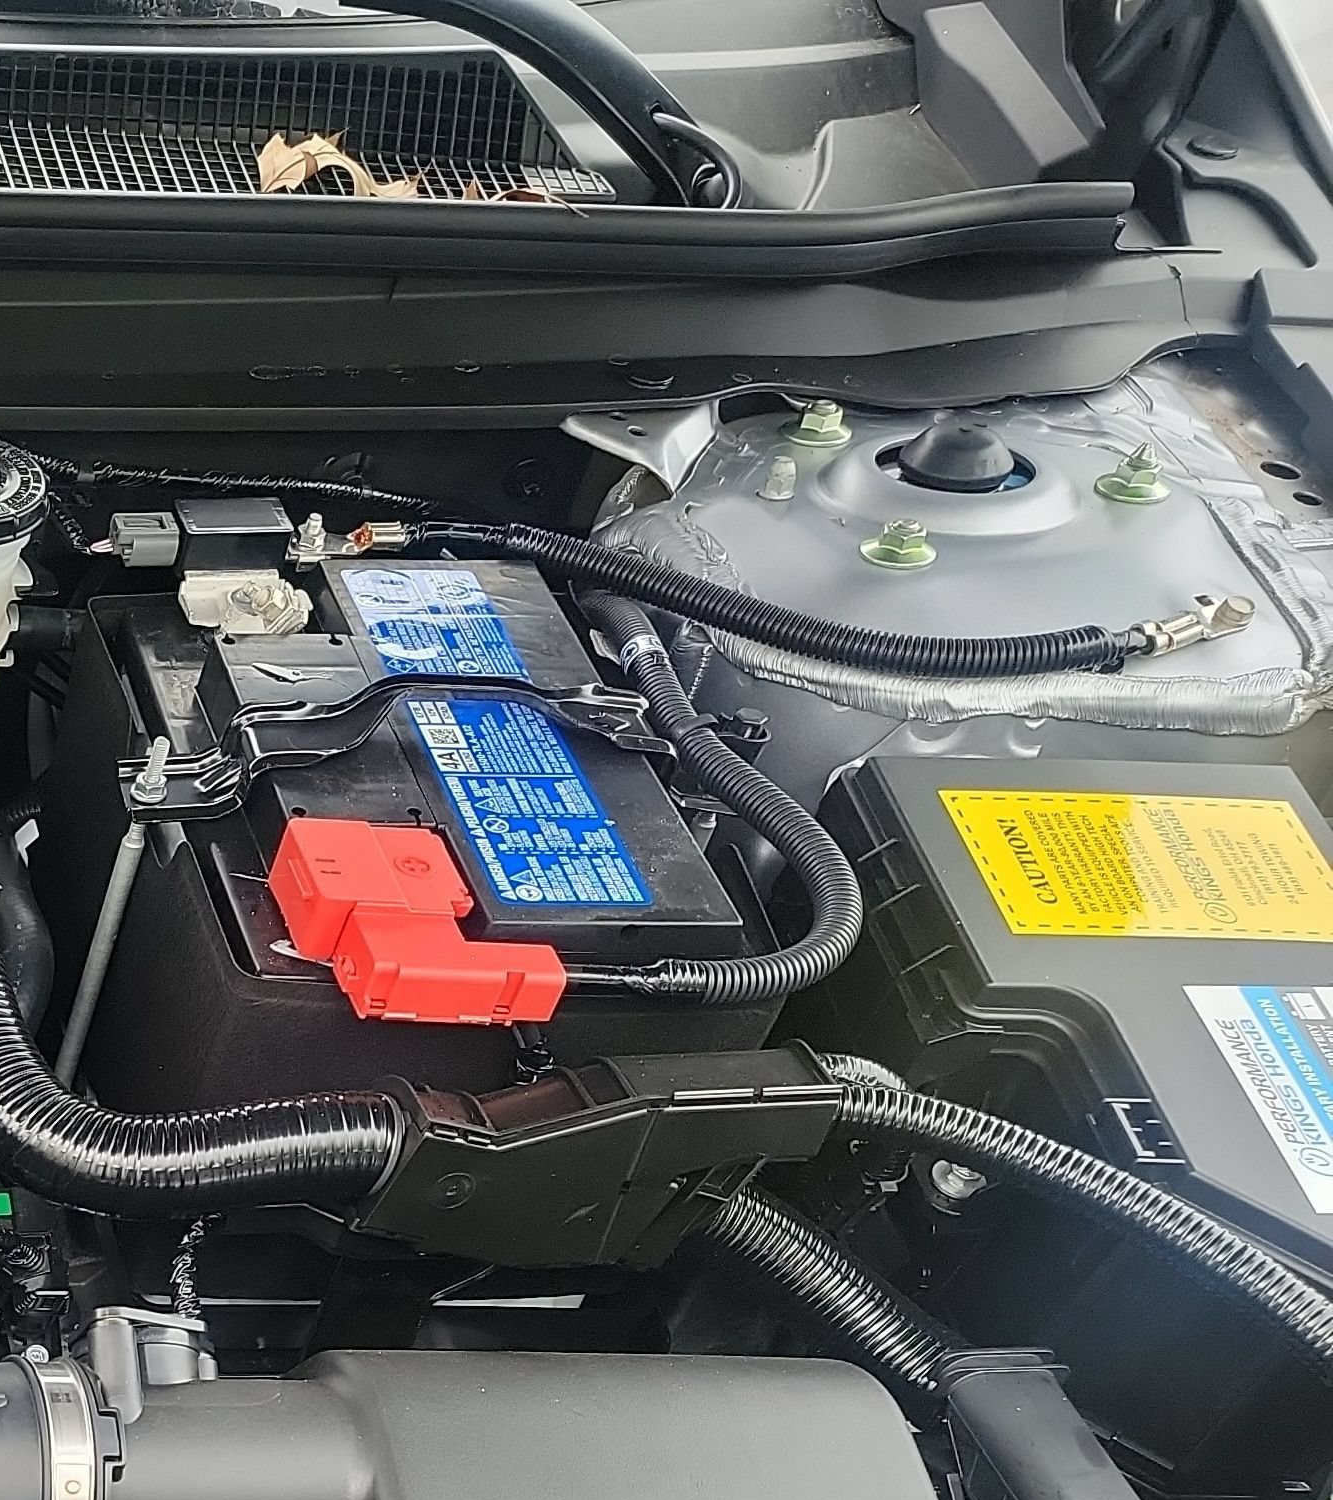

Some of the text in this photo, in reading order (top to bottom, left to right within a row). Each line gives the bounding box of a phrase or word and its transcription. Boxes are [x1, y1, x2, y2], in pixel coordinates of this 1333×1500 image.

[434, 751, 463, 769] 4A
[1036, 812, 1056, 830] MILE
[1049, 812, 1068, 829] THIS
[1062, 811, 1083, 830] WITH
[1073, 833, 1106, 870] EQUIPPED
[1096, 824, 1123, 855] SPECIAL
[1112, 830, 1136, 855] TOOLS
[1143, 808, 1210, 899] PERFORMANCE
[1159, 808, 1227, 900] KINGS Honda
[994, 818, 1060, 904] CAUTION!
[1021, 810, 1089, 914] MANY PARTS ARE COVERED
[1077, 814, 1142, 912] AN ON BOARD HIGH TECH
[1078, 889, 1094, 899] AN
[1085, 877, 1115, 912] FACTORY
[1085, 901, 1100, 911] BY
[1101, 882, 1130, 914] VEHICLE
[1138, 875, 1170, 913] TRAINING
[1257, 998, 1319, 1087] INSTALLATION
[1214, 1019, 1305, 1145] PERFORMANCE
[1239, 1019, 1326, 1145] KINGS Honda
